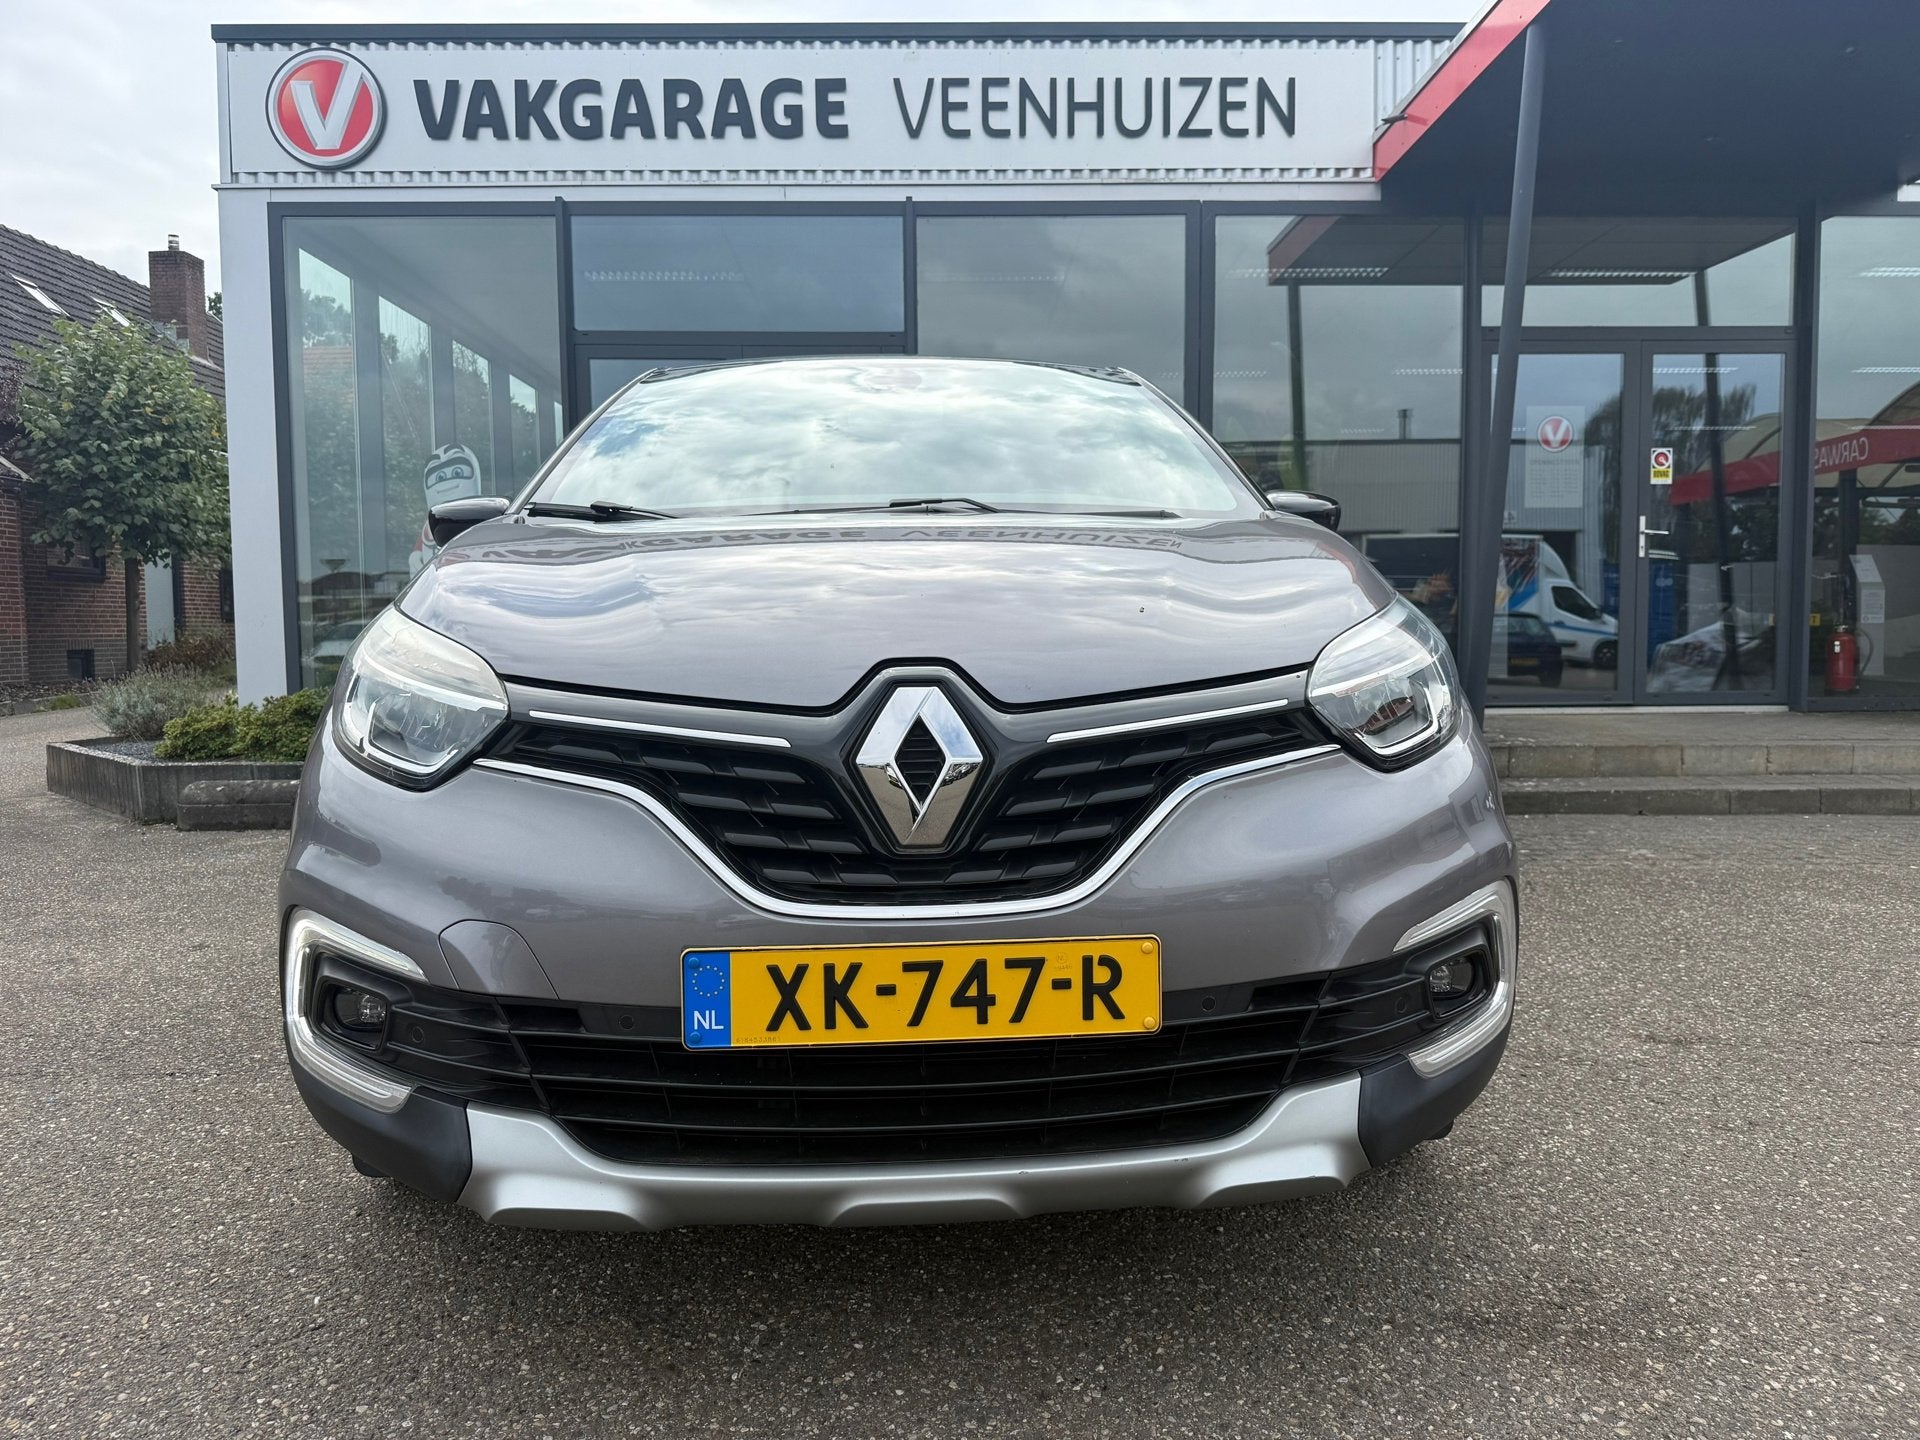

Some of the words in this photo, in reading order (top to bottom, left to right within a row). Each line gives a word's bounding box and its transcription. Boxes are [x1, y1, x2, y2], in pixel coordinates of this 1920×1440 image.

[414, 78, 849, 141] VAKGARAGE
[893, 77, 1296, 139] VEENHUIZEN
[693, 1010, 724, 1030] NL
[766, 954, 1125, 1031] XK-747-R
